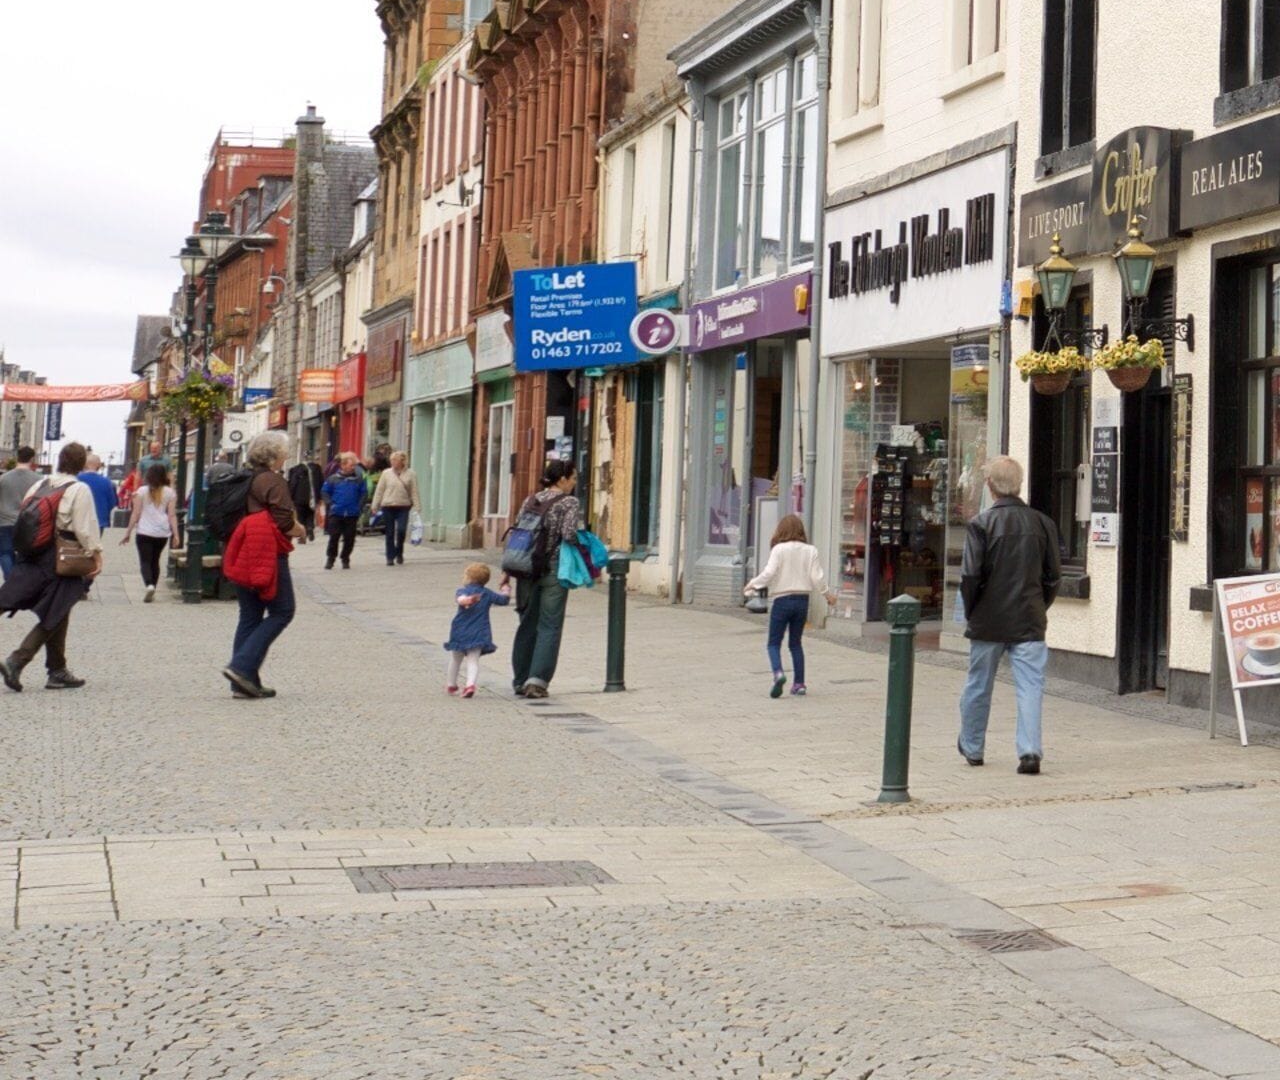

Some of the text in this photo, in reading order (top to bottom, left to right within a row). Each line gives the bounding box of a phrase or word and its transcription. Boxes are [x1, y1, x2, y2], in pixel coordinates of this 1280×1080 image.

[1102, 142, 1157, 231] Crofter
[1192, 150, 1263, 197] REAL ALES
[1028, 202, 1085, 239] LIVE SPORT
[532, 342, 622, 359] 01463 717202
[1230, 603, 1266, 619] RELAX
